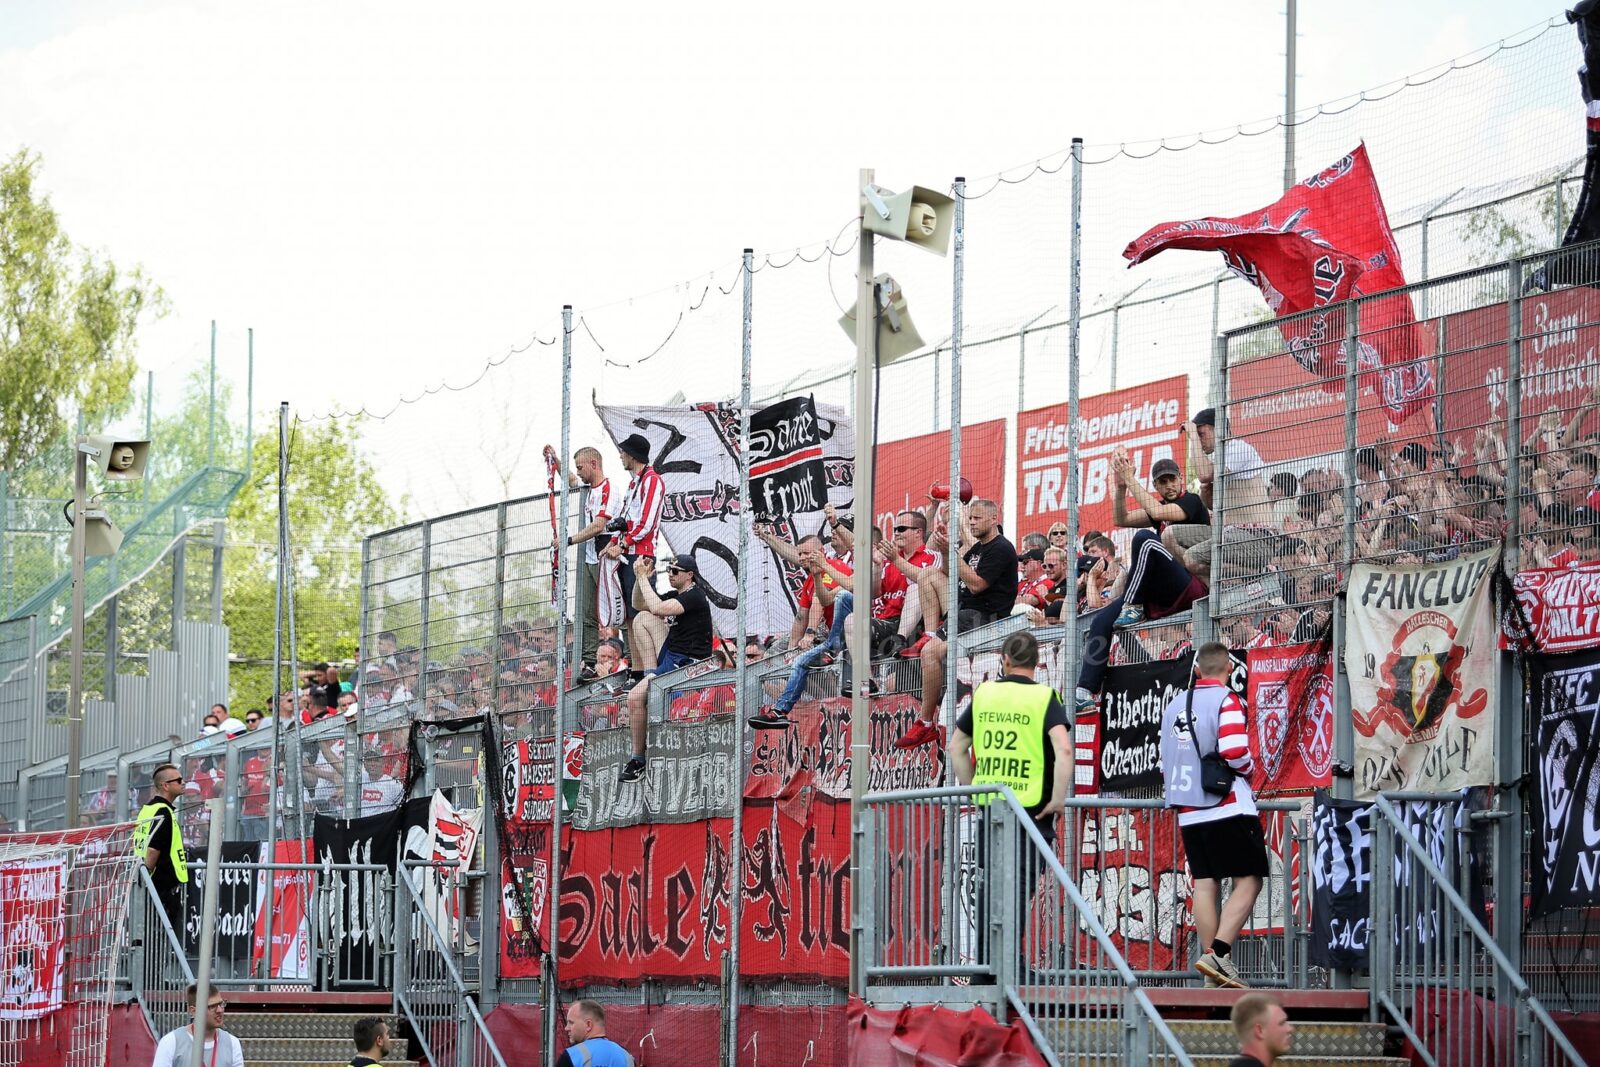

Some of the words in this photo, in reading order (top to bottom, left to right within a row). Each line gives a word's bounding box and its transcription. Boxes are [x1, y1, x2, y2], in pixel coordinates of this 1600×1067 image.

[1024, 445, 1182, 516] TRABLA
[979, 711, 1031, 725] STEWARD
[983, 730, 1018, 750] 092
[976, 757, 1031, 779] EMPIRE
